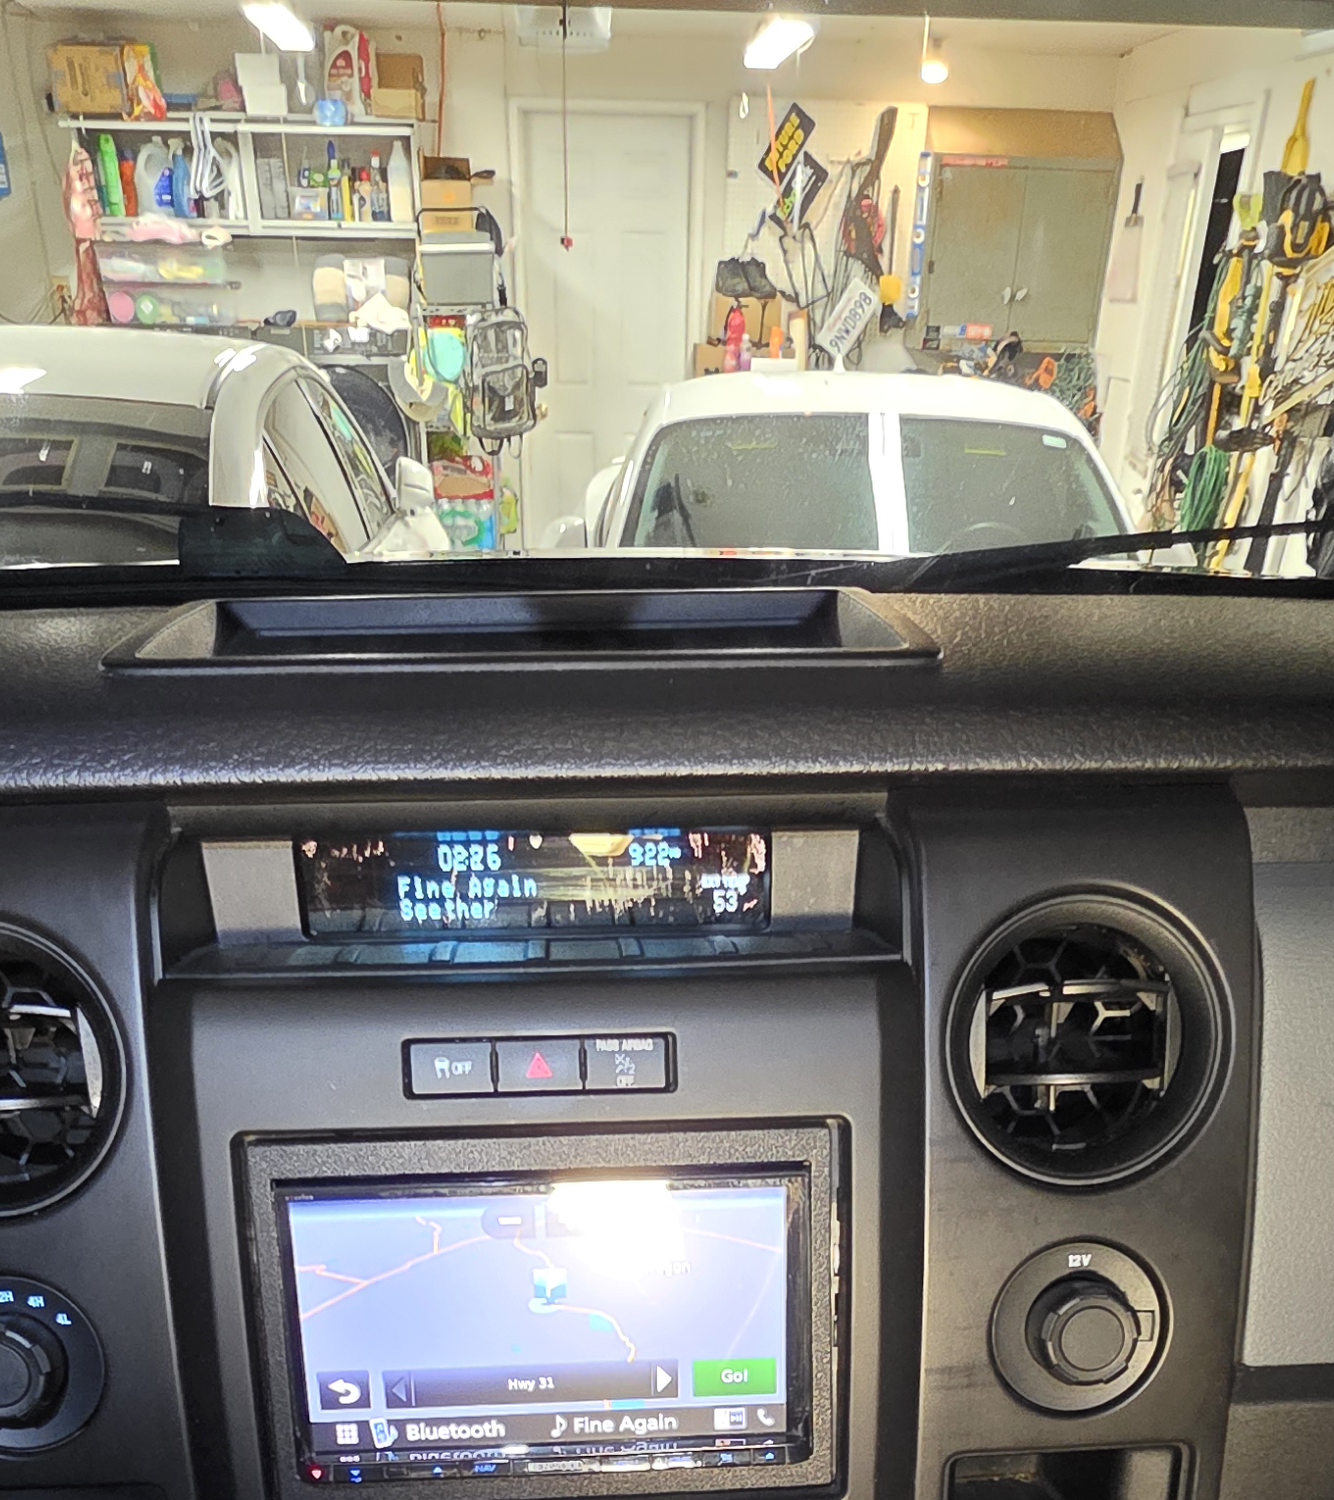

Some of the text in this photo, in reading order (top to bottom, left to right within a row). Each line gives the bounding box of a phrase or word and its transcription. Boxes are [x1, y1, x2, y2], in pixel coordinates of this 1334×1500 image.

[399, 899, 495, 922] Seether
[713, 890, 738, 914] 53
[1068, 1254, 1092, 1268] 12V
[508, 1377, 555, 1392] Hwy 31
[721, 1368, 748, 1384] Go!
[405, 1419, 506, 1442] Bluetooth
[573, 1413, 678, 1436] Fine Again
[475, 1464, 497, 1474] NAV
